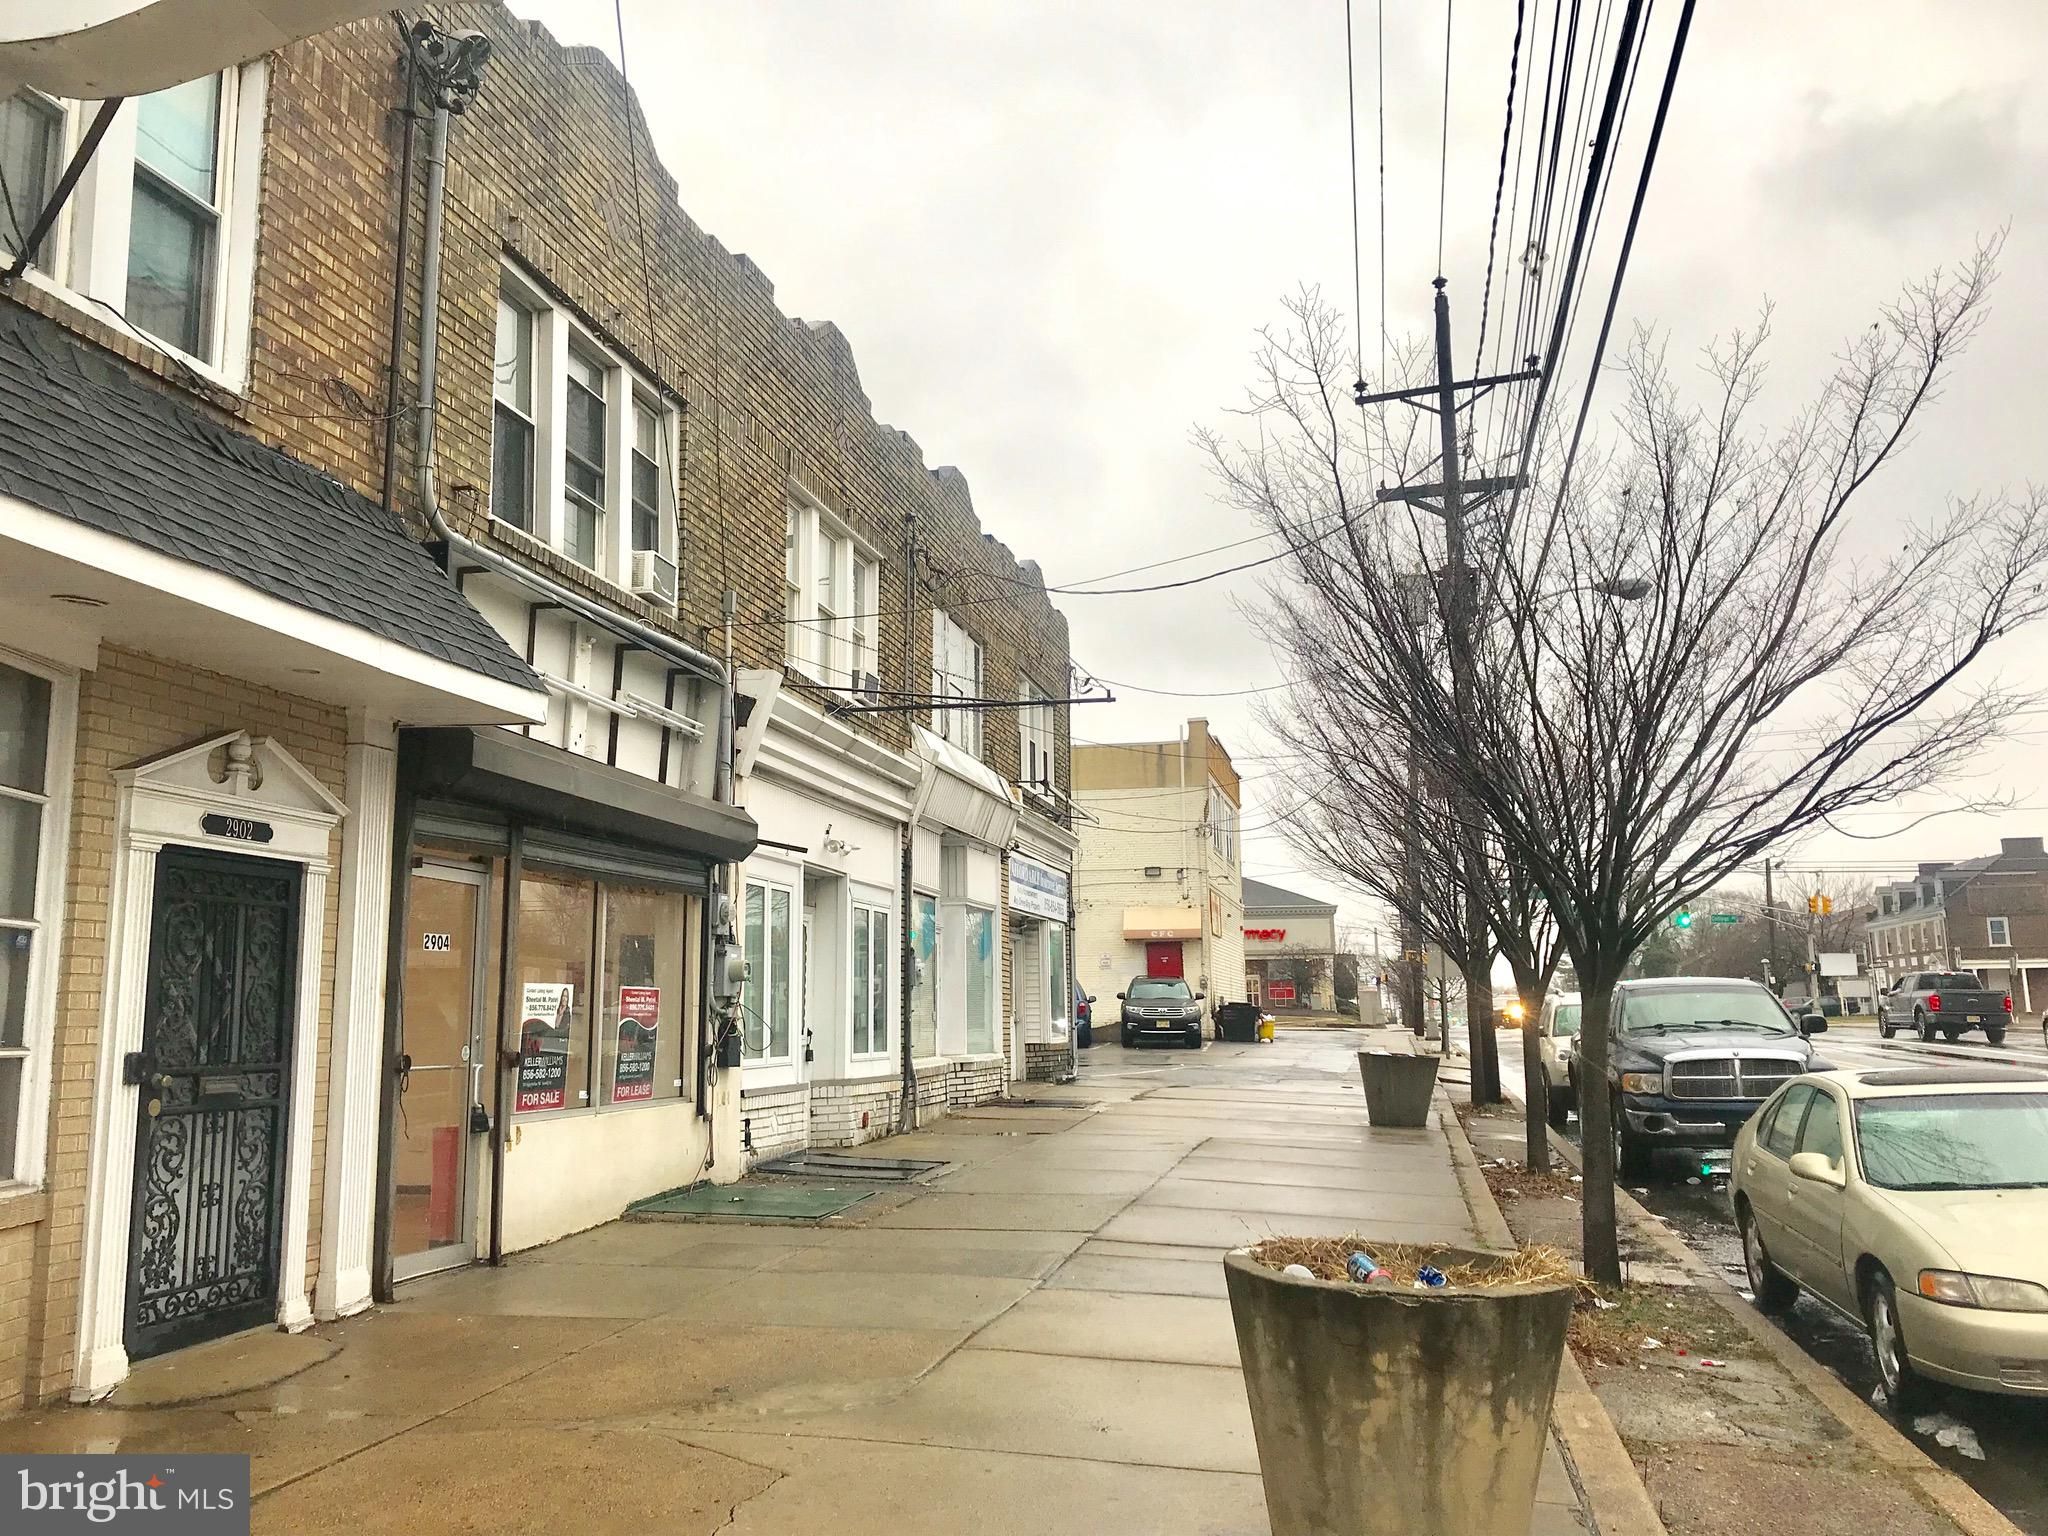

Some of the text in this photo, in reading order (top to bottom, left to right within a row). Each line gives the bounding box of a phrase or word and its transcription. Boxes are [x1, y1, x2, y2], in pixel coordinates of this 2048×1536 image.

[226, 818, 253, 839] 2902
[424, 934, 449, 950] 2904
[522, 1067, 562, 1080] 856-582-1200
[616, 1084, 651, 1097] FOR LEASE
[521, 1091, 560, 1106] FOR SALE
